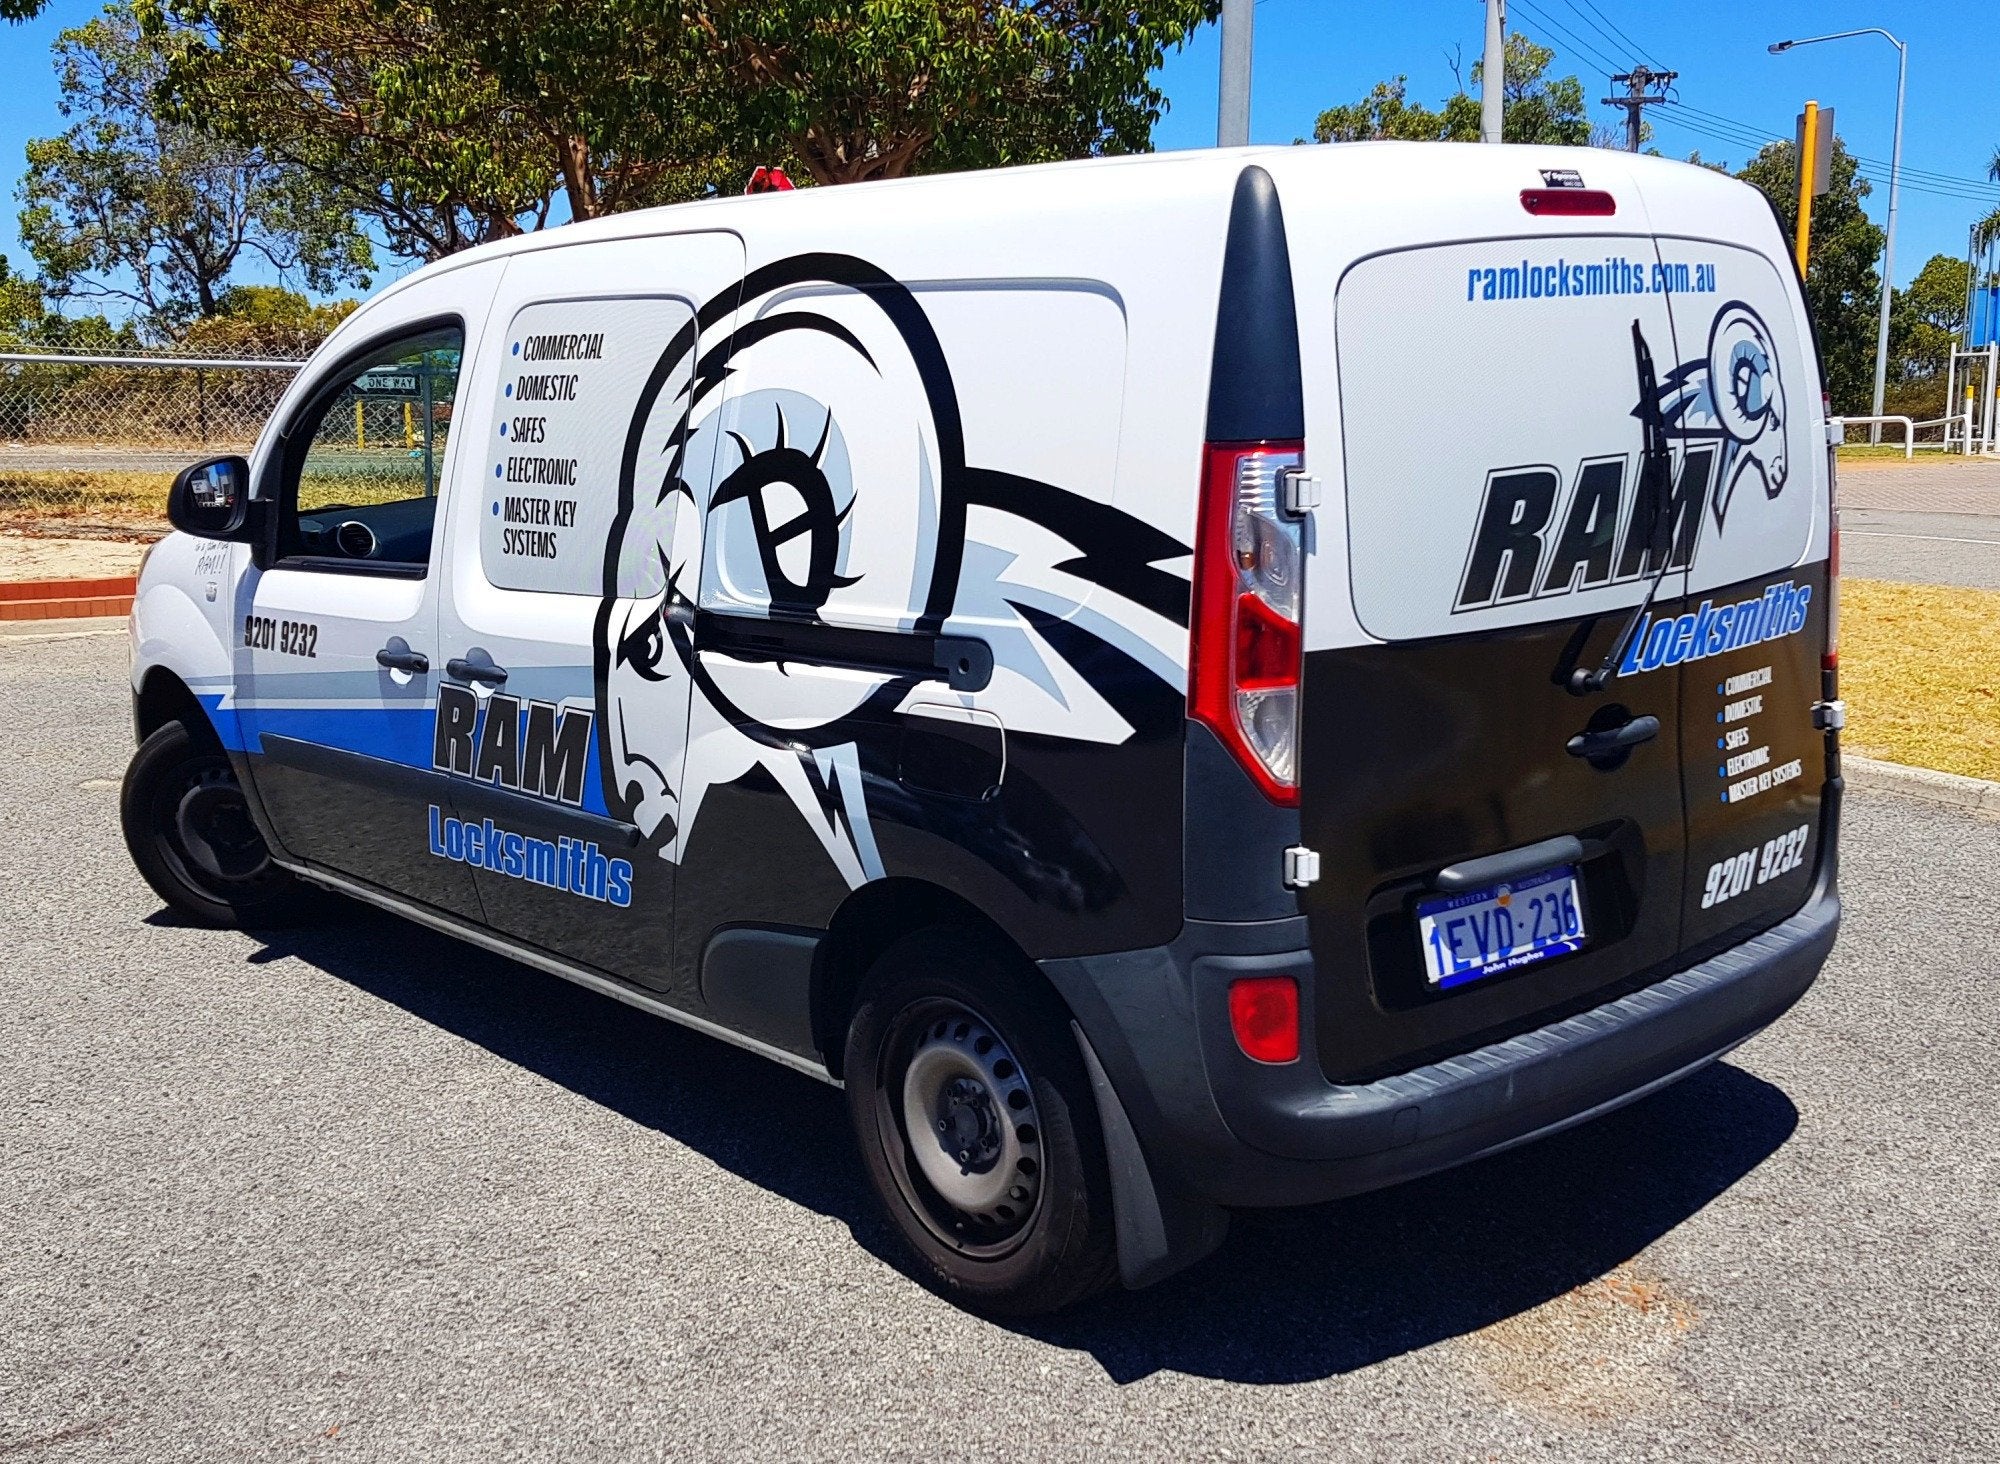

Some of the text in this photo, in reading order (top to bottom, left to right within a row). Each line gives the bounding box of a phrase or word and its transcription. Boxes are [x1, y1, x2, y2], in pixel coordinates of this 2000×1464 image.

[1467, 257, 1715, 302] ramlocksmiths.com.au
[523, 333, 604, 361] COMMERCIAL
[368, 378, 413, 388] ONE WAY
[516, 374, 578, 401] DOMESTIC
[510, 416, 546, 443] SAFES
[506, 456, 577, 486] ELECTRONIC
[504, 496, 577, 527] MASTER KEY
[1450, 437, 1724, 615] RAM
[502, 527, 557, 559] SYSTEMS
[244, 614, 317, 658] 9201 9232
[1617, 580, 1812, 677] Locksmiths
[432, 680, 595, 809] RAM
[1725, 726, 1749, 751] SAFES
[428, 804, 634, 908] Locksmiths
[1701, 823, 1810, 910] 9201 9232
[1482, 950, 1545, 975] John Hughes
